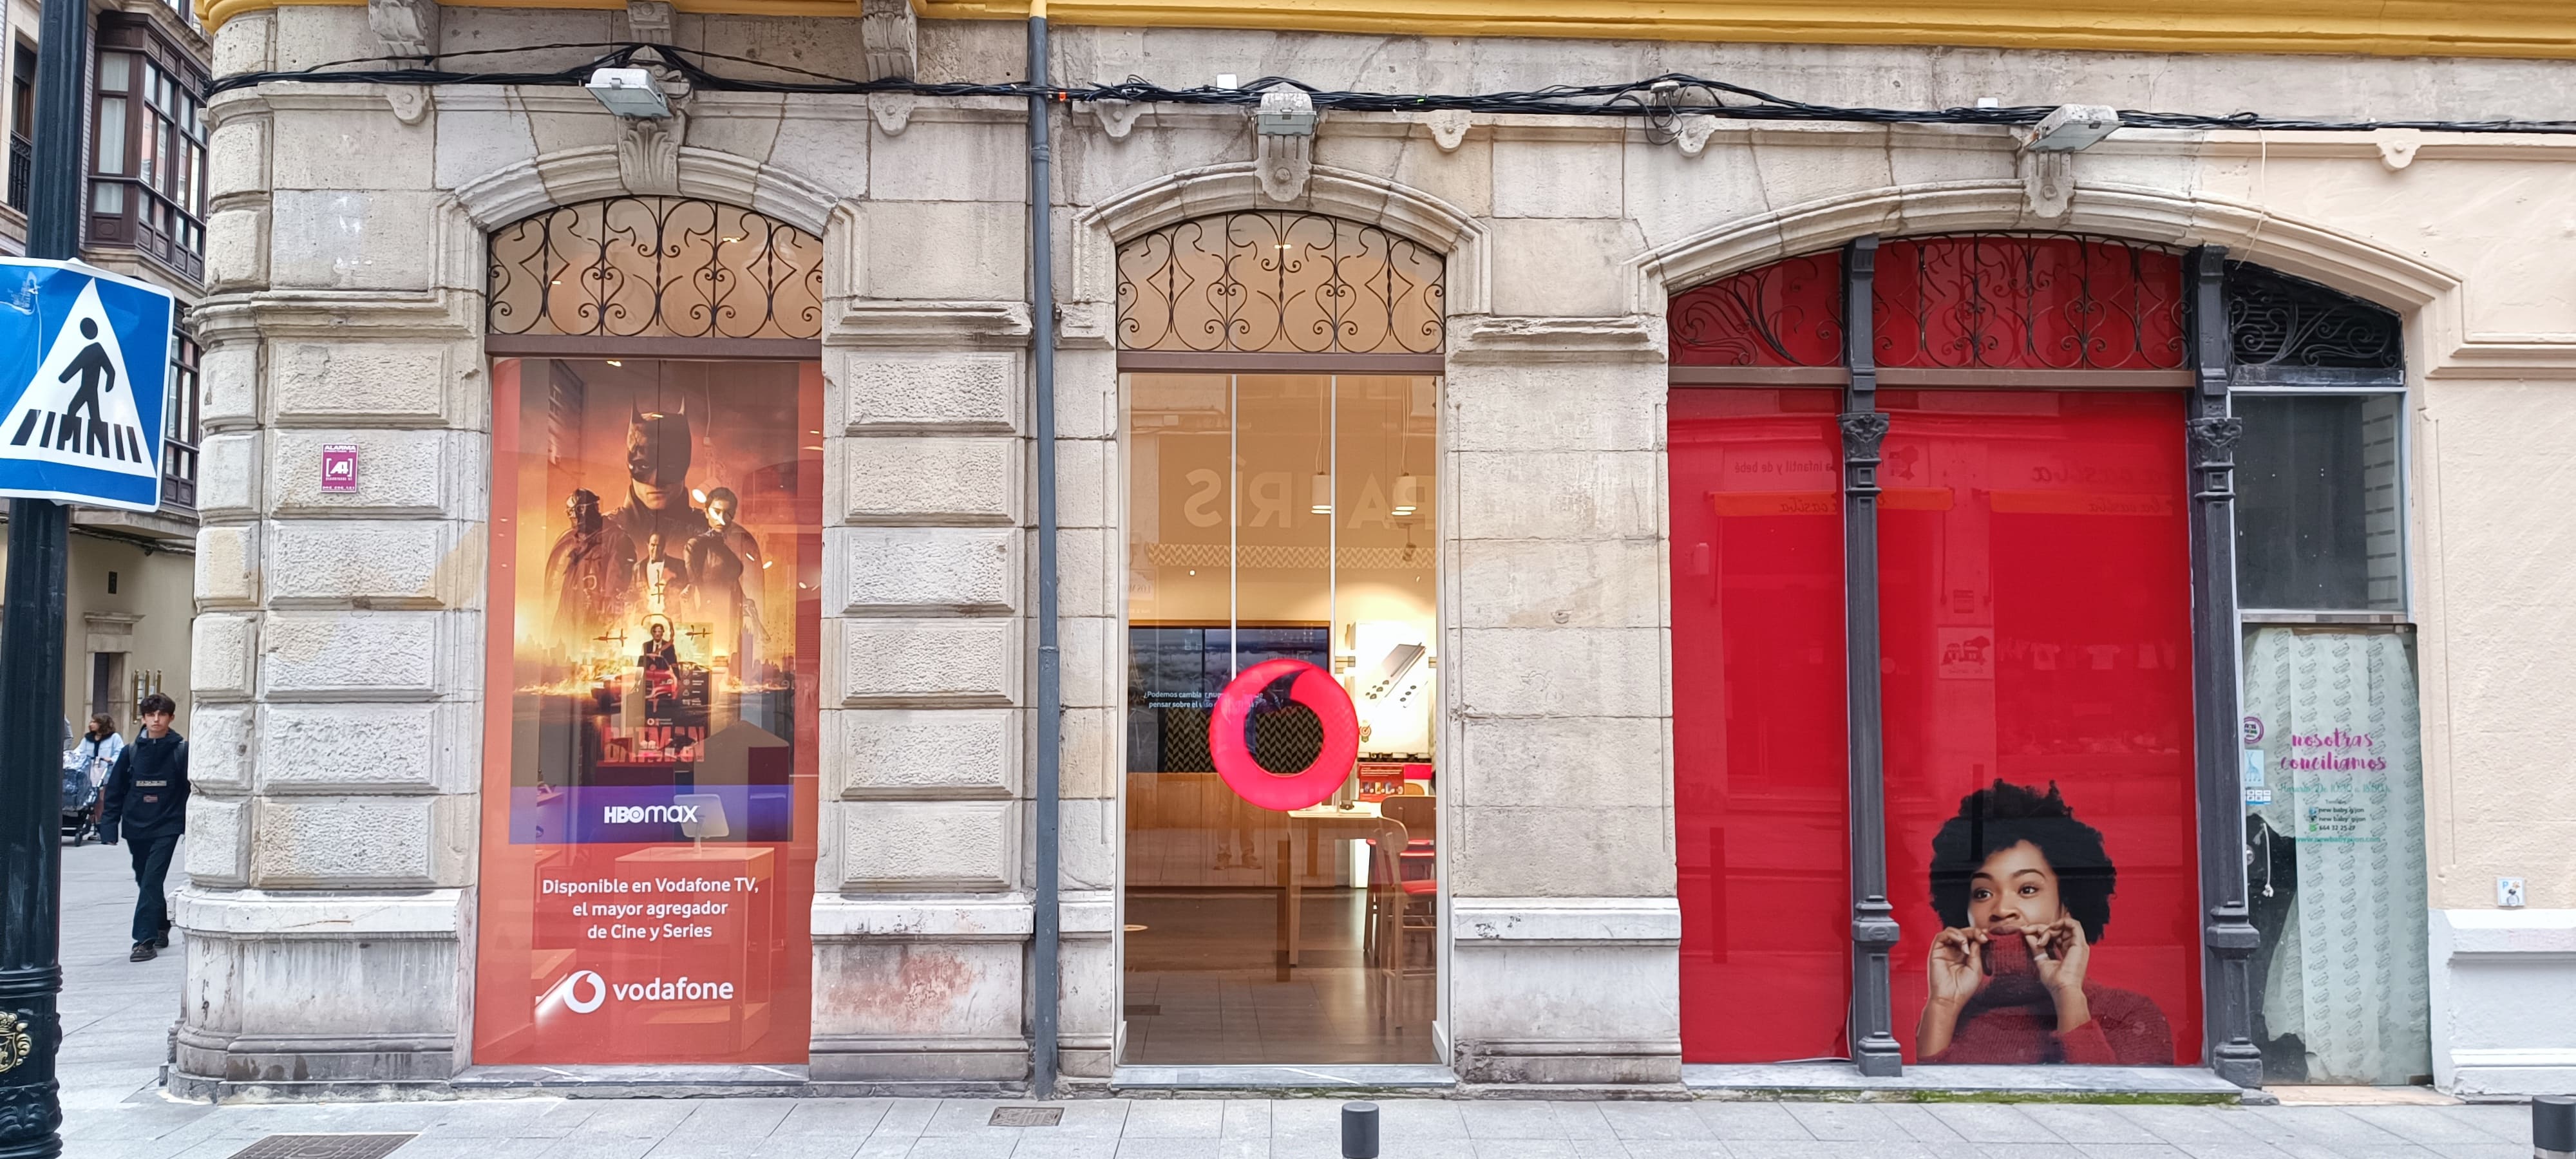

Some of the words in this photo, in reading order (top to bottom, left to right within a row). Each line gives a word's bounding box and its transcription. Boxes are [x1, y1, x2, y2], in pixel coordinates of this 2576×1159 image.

[2292, 728, 2373, 748] nosotras
[2280, 751, 2387, 771] conciliamos
[542, 879, 629, 897] Disponible
[632, 881, 652, 893] en
[655, 877, 731, 893] Vodafone
[734, 876, 759, 894] TV,
[573, 902, 588, 916] el
[592, 904, 643, 919] mayor
[646, 900, 728, 919] agregador
[587, 925, 607, 939] de
[611, 923, 647, 939] Cine
[649, 927, 660, 941] y
[663, 923, 712, 938] Series
[612, 977, 734, 1001] vodafone
